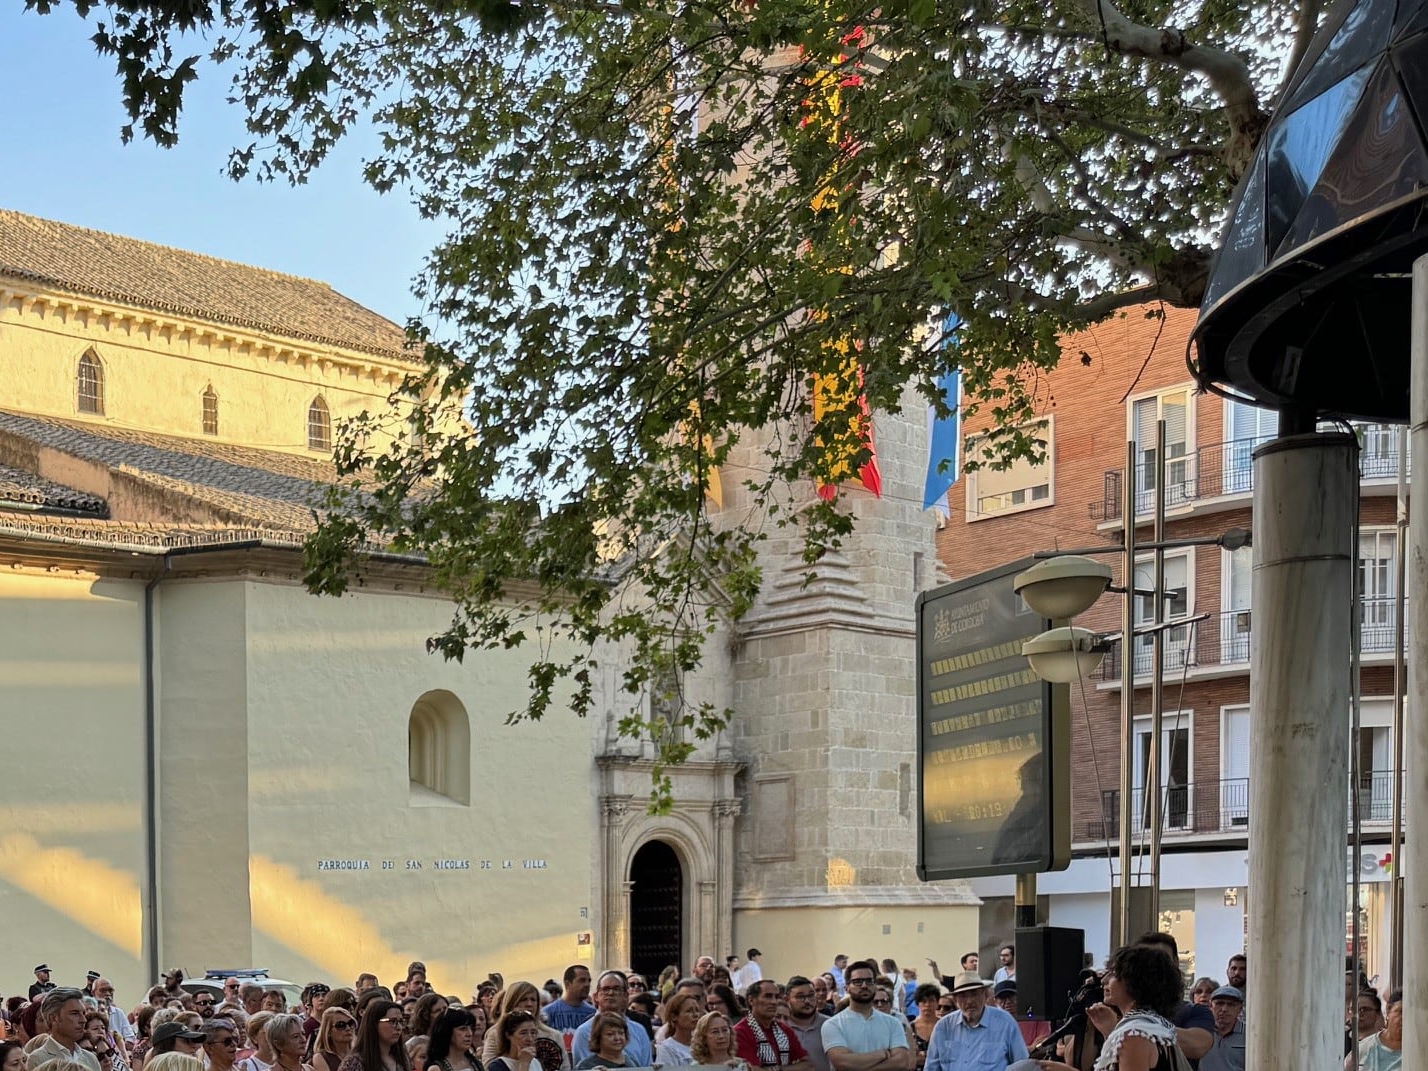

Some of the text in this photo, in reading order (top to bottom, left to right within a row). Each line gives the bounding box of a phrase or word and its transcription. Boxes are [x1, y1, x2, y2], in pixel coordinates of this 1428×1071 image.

[318, 860, 370, 870] PARROQUIA
[382, 860, 394, 870] DE
[406, 860, 422, 870] SAN
[480, 860, 492, 870] DE
[502, 860, 512, 869] LA
[523, 860, 548, 869] VILLA
